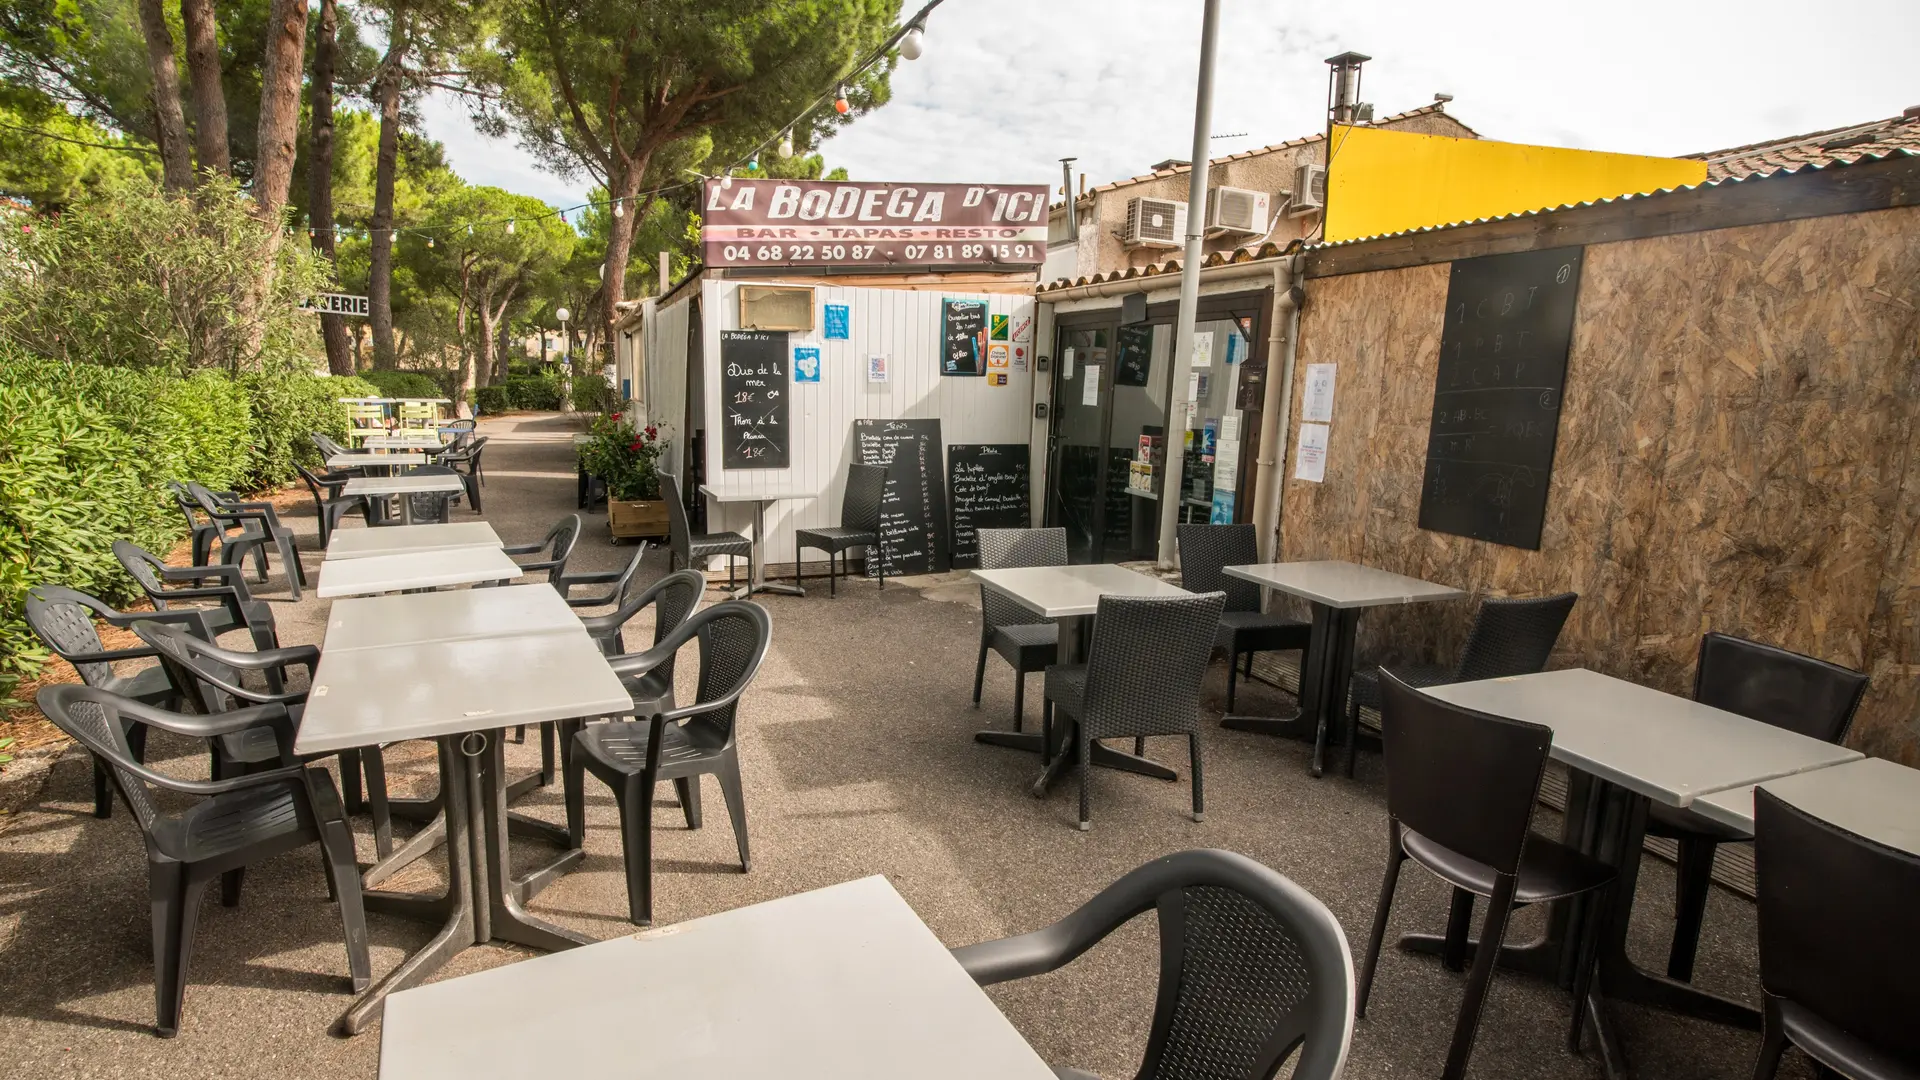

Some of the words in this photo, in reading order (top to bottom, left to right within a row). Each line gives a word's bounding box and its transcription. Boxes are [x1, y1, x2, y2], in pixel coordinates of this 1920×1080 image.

[706, 185, 756, 211] LA
[767, 185, 946, 222] BODEGA
[962, 187, 1045, 222] D'ICI
[736, 228, 797, 239] BAR
[827, 228, 913, 238] TAPAS
[723, 245, 751, 261] 04
[756, 245, 783, 261] 68
[789, 245, 815, 260] 22
[821, 245, 846, 260] 50
[851, 245, 876, 260] 87
[904, 245, 928, 260] 07
[933, 245, 953, 259] 81
[961, 244, 984, 259] 89
[990, 244, 1010, 258] 15
[1014, 244, 1034, 258] 91
[727, 361, 754, 377] Duo
[757, 363, 769, 375] de
[772, 362, 783, 376] la
[745, 379, 766, 387] mer
[734, 391, 755, 404] 18€
[729, 413, 752, 426] Thon
[756, 416, 765, 425] à
[769, 415, 779, 425] la
[742, 446, 766, 459] 18€
